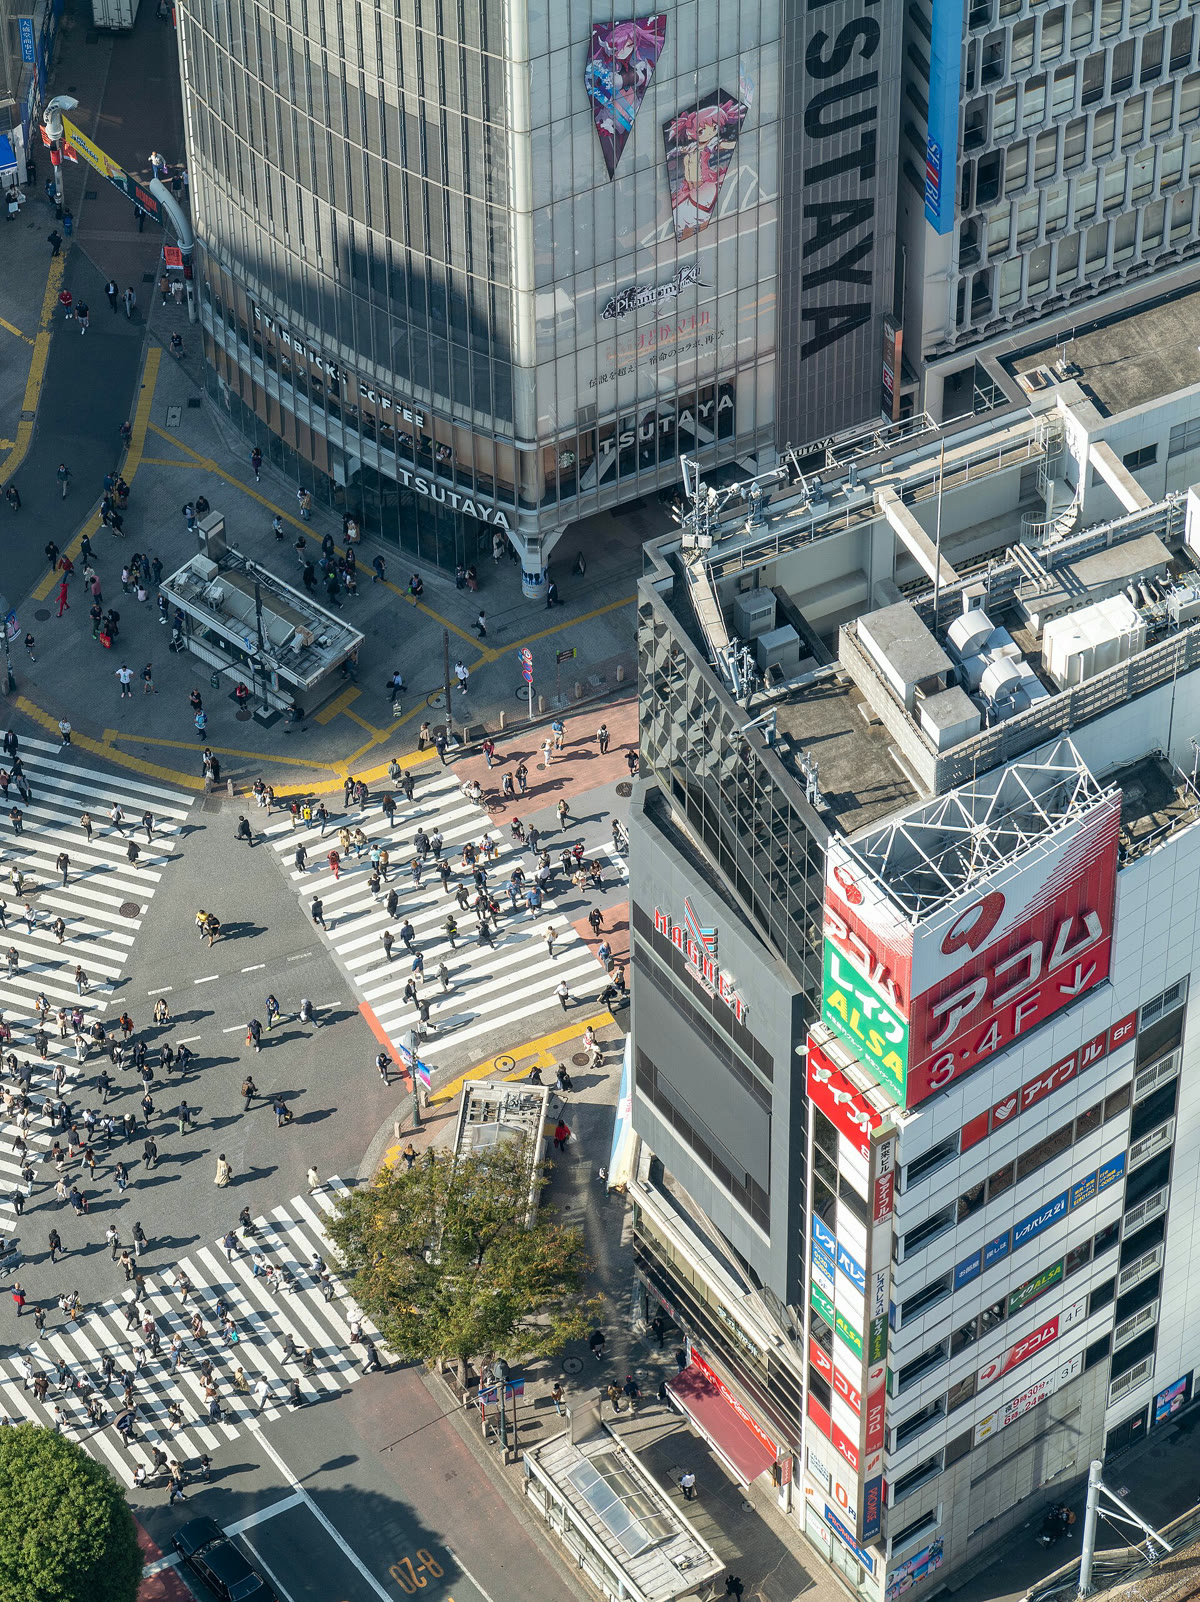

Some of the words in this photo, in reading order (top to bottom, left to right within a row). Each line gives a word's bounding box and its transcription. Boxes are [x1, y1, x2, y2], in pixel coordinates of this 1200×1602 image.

[926, 142, 941, 217] SEIBU
[253, 307, 349, 386] STARBUCKS
[359, 383, 424, 429] COFFEE
[599, 394, 735, 455] TSUTAYA
[399, 468, 511, 529] TSUTAYA
[654, 905, 748, 1027] MAGNET
[824, 904, 898, 1007] アコム
[831, 952, 905, 1045] レイク
[931, 910, 1104, 1050] アコム
[826, 989, 904, 1084] ALSA
[1023, 1038, 1103, 1105] アイフル
[1113, 1022, 1133, 1041] 8F
[878, 1182, 890, 1219] アイフル
[1015, 1199, 1065, 1241] レオパレス21
[958, 1259, 980, 1278] お部屋
[1010, 1284, 1034, 1306] レイク
[1033, 1266, 1062, 1291] ALSA
[812, 1286, 834, 1316] レイク
[836, 1317, 862, 1349] ALSA
[1064, 1304, 1083, 1323] 4F
[1015, 1326, 1055, 1360] アコム
[816, 1350, 862, 1410] アコム
[1061, 1360, 1079, 1379] 3F
[869, 1404, 882, 1435] アコム
[838, 1440, 857, 1467] 入口
[866, 1486, 878, 1523] PROMISE
[827, 1511, 858, 1550] PROMISE
[389, 1548, 445, 1595] 8-20
